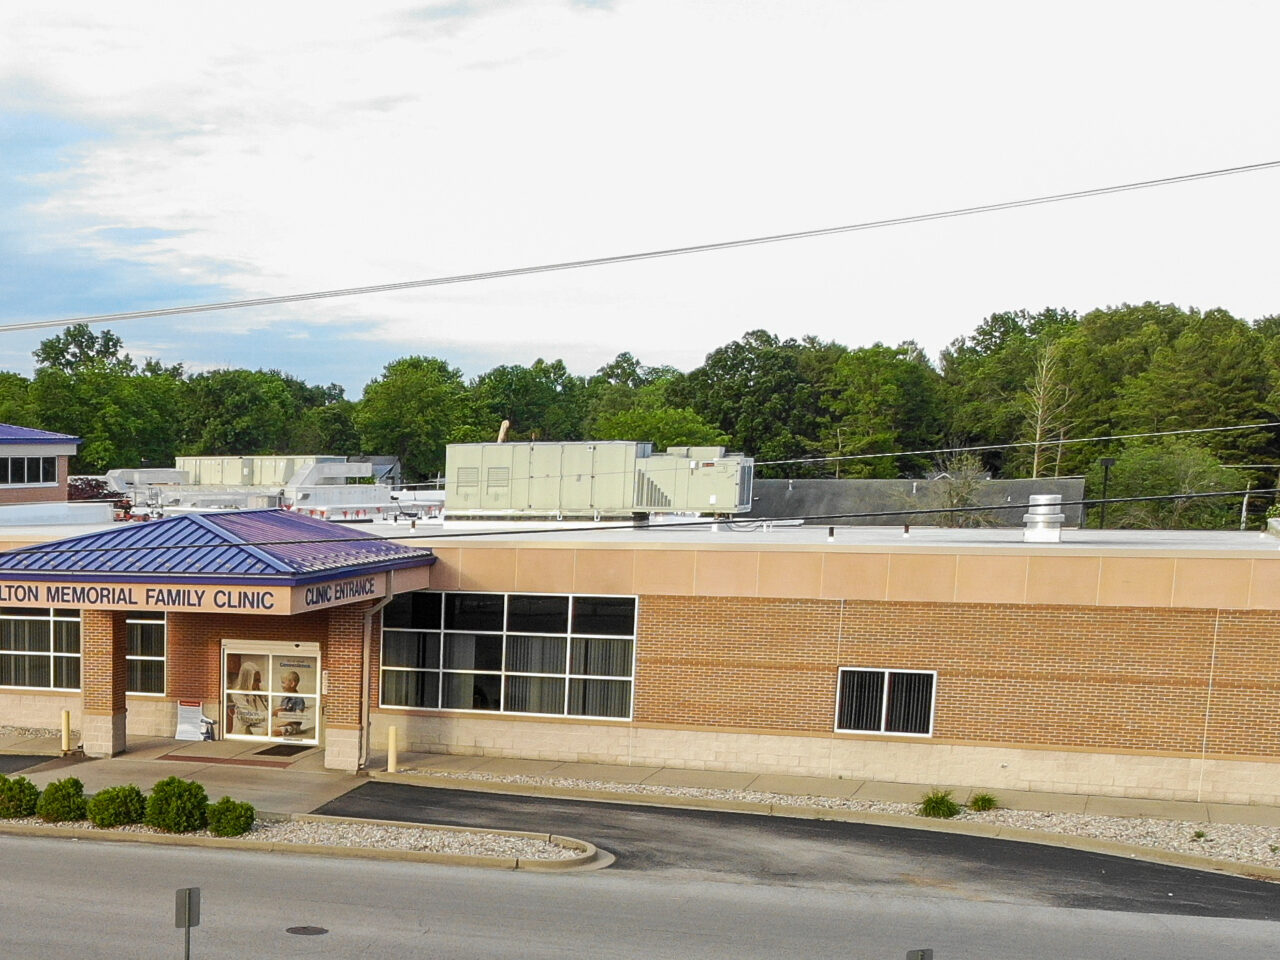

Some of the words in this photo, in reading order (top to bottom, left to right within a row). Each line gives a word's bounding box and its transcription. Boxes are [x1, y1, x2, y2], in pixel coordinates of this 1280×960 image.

[46, 586, 138, 605] MEMORIAL
[145, 588, 206, 607] FAMILY
[213, 590, 275, 610] CLINIC
[304, 583, 332, 606] CLINIC
[334, 578, 375, 600] ENTRANCE
